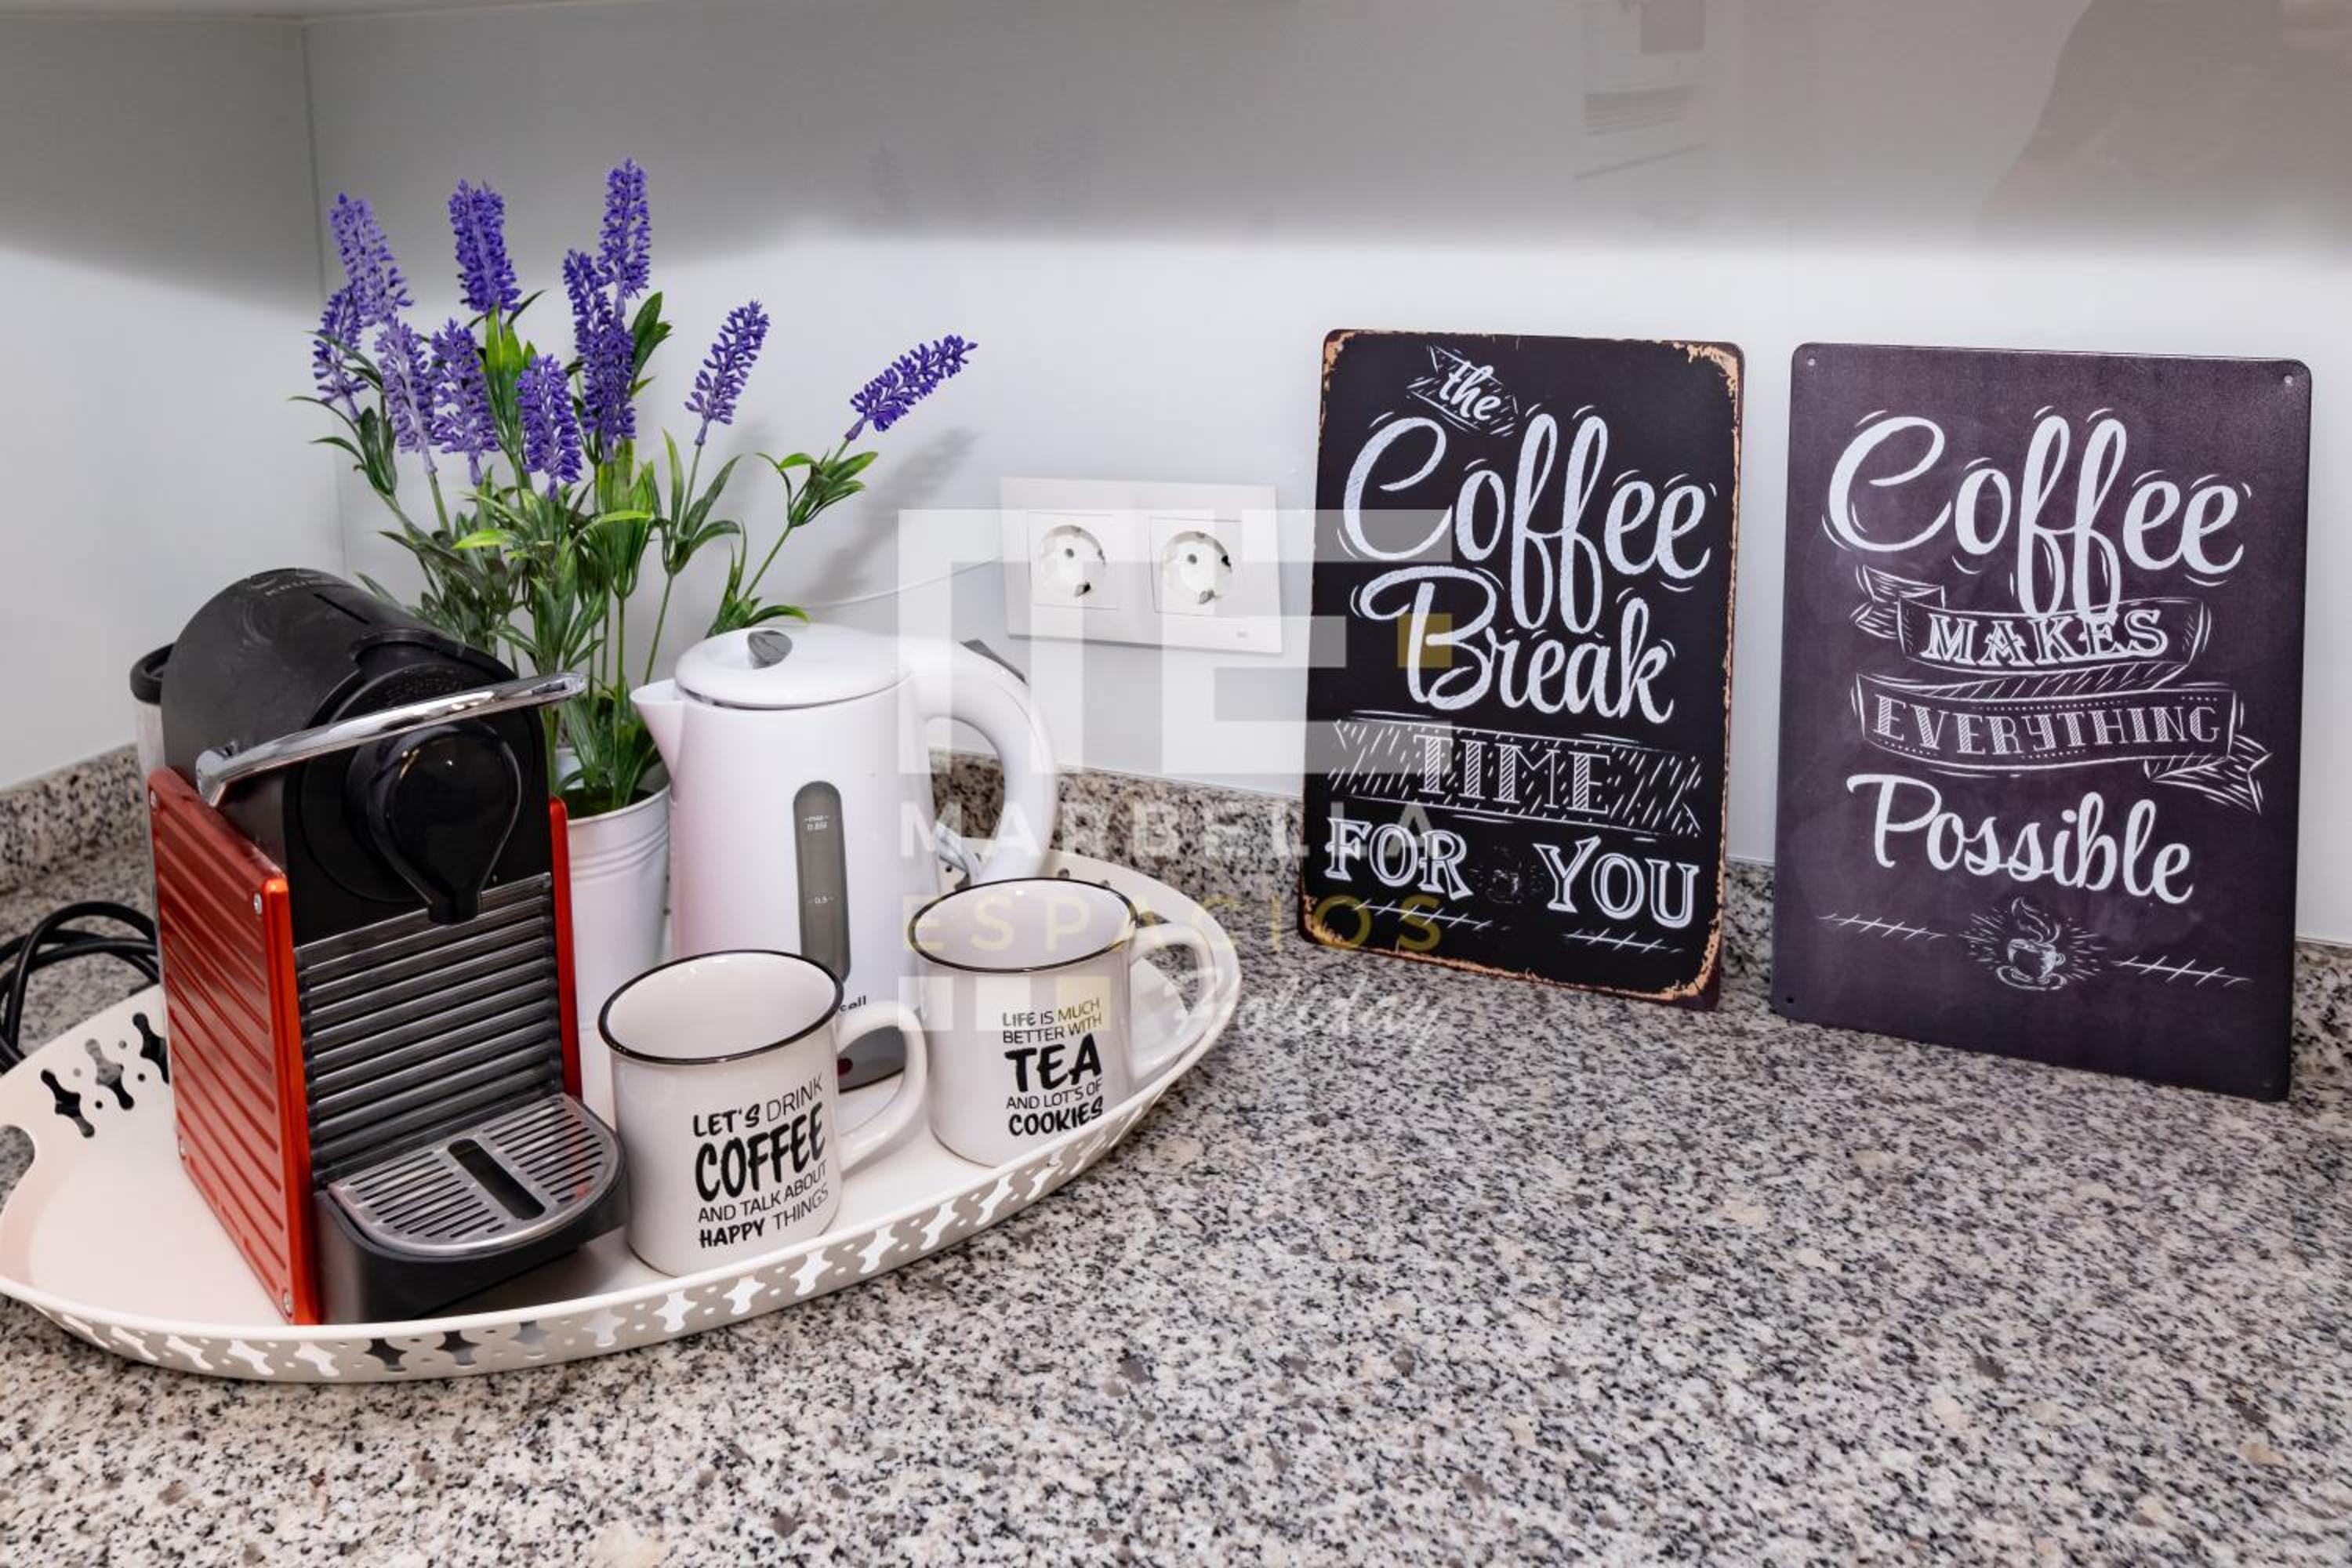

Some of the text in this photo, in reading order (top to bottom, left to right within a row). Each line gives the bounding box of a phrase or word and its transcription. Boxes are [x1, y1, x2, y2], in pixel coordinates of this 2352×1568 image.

[1439, 361, 1501, 421] the
[1343, 413, 1711, 633] Coffee
[1828, 415, 2244, 621] Coffee
[1359, 565, 1674, 724] Break
[1920, 608, 2169, 666] MAKES
[1873, 694, 2221, 755] EVERYTHING
[1413, 734, 1611, 815] TIME
[1324, 816, 1700, 928] FOR YOU
[1846, 774, 2194, 905] Possible
[1003, 997, 1100, 1027] LIFE IS MUCH
[1003, 1013, 1102, 1044] BETTER WITH
[1004, 1033, 1102, 1092] TEA
[1006, 1095, 1040, 1109] AND
[1086, 1076, 1103, 1096] OF
[693, 1071, 823, 1138] LET'S DRINK
[1008, 1095, 1104, 1136] COOKIES
[695, 1101, 826, 1202] COFFEE
[698, 1159, 827, 1224] AND TALK ABOUT
[699, 1182, 829, 1248] HAPPY THINGS
